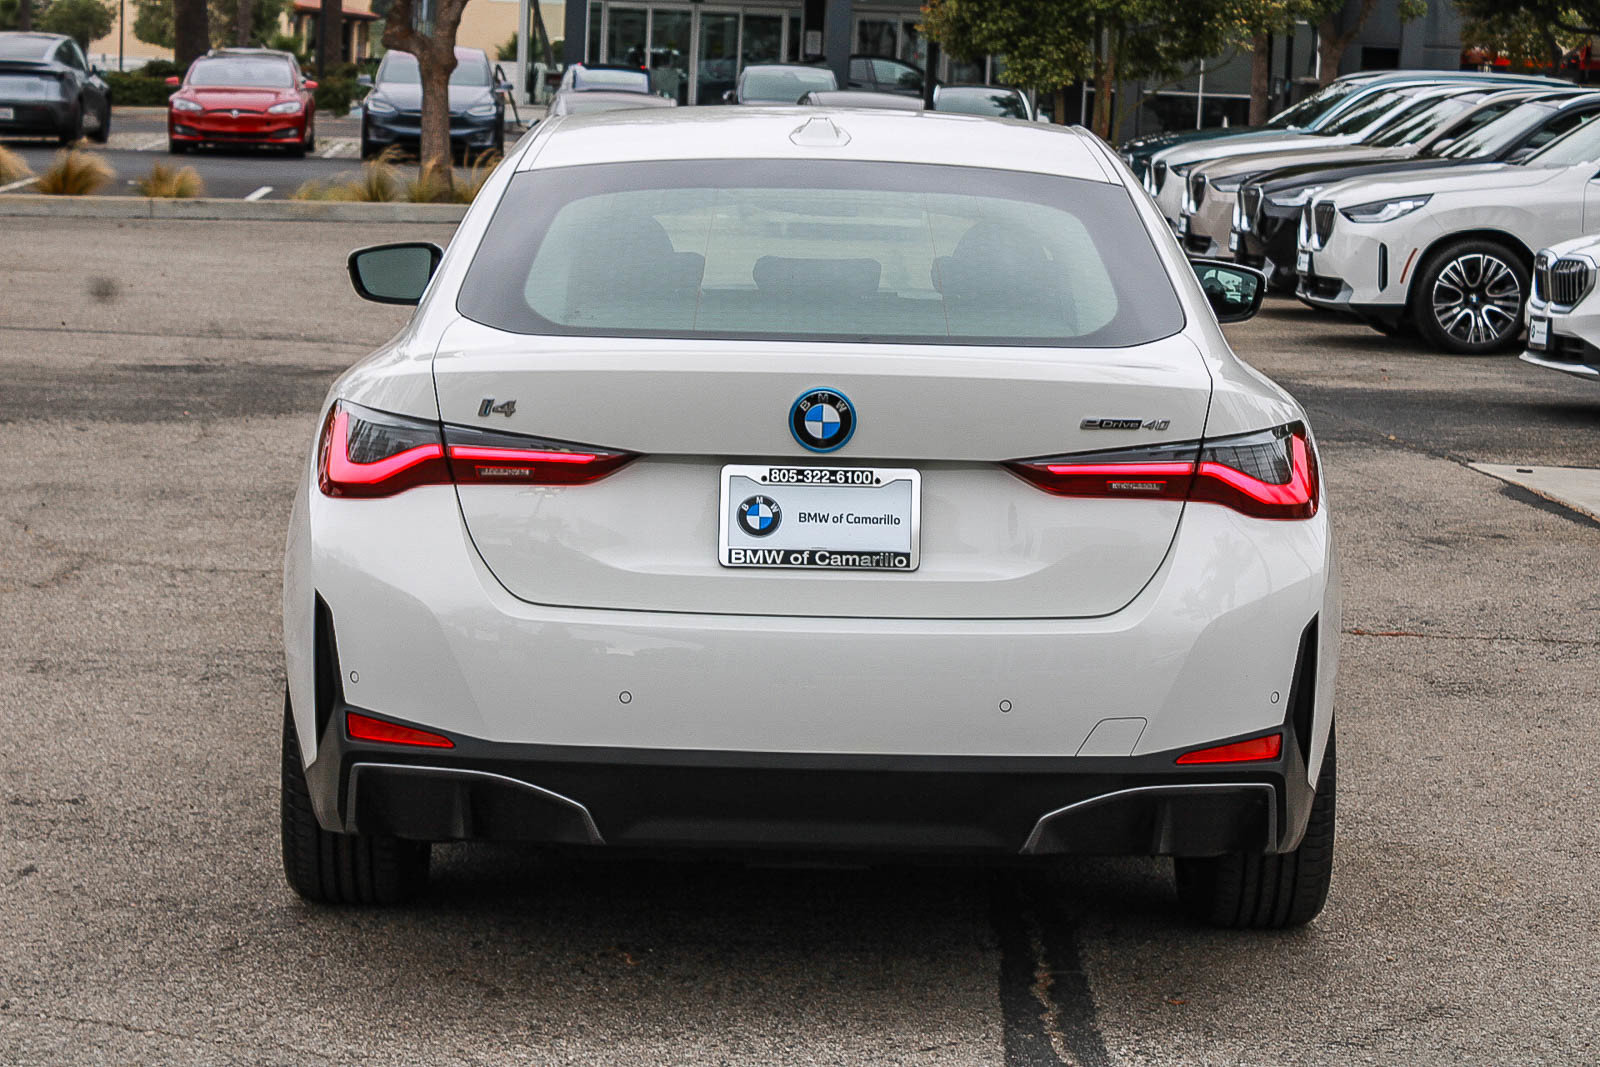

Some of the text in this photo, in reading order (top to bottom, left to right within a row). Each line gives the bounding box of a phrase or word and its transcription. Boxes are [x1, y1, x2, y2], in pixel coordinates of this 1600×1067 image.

[478, 398, 517, 417] i4
[799, 393, 848, 412] BMW
[770, 469, 872, 484] 805-322-6100
[741, 496, 780, 513] BMW
[798, 512, 901, 526] BMW of Camarillo
[731, 549, 907, 567] BMW of Camarillo
